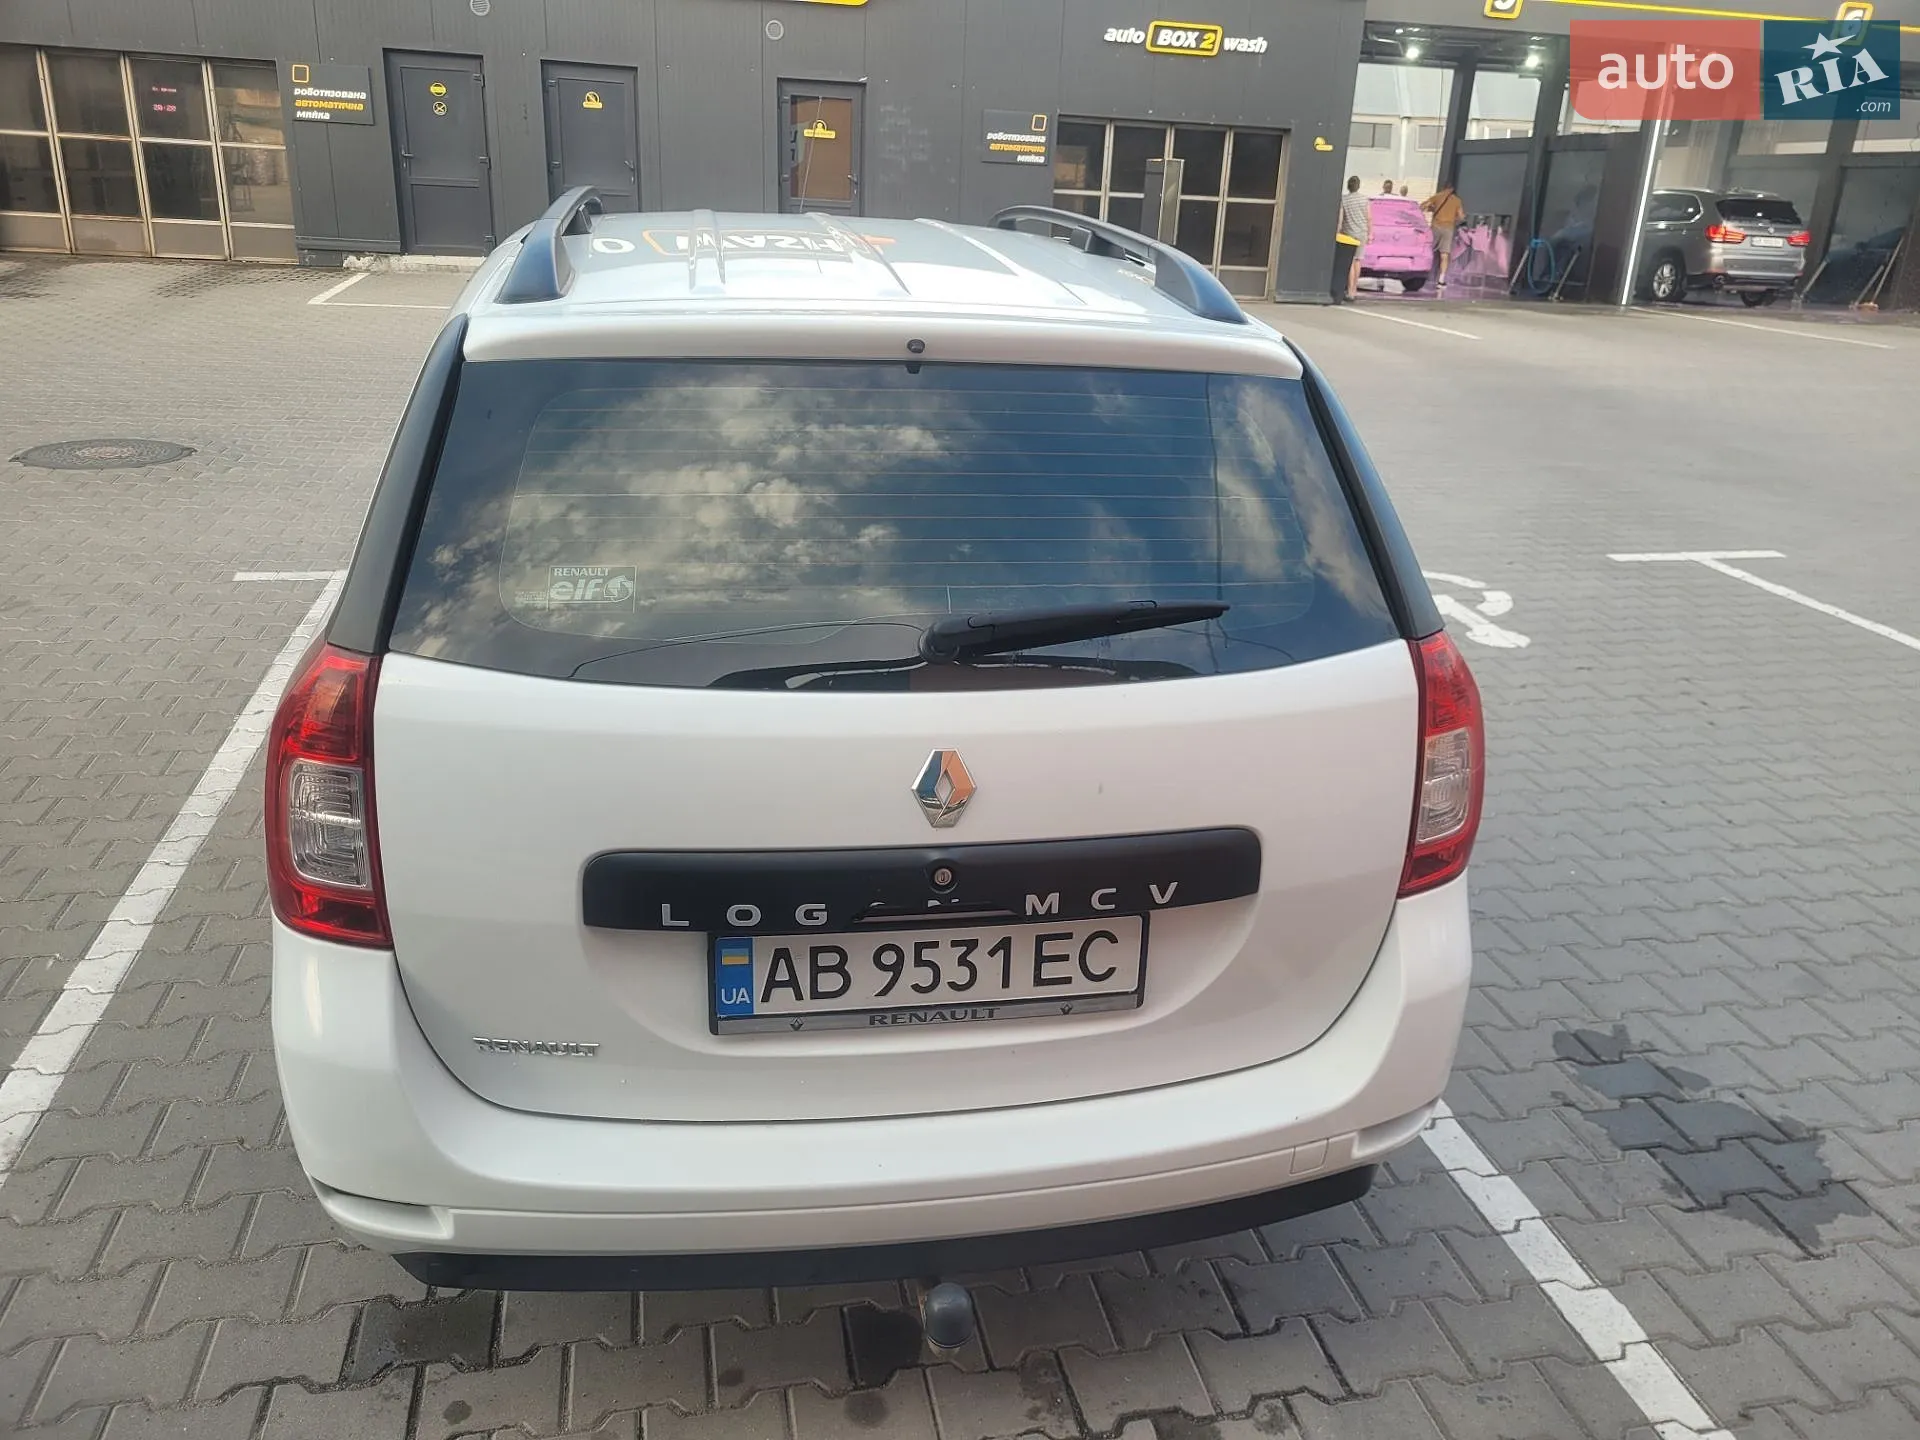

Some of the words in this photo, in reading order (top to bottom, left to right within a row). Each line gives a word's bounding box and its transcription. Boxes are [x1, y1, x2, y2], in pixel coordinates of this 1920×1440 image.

[1103, 27, 1146, 44] auto
[1156, 29, 1199, 48] BOX
[1200, 32, 1216, 49] 2
[1223, 37, 1268, 53] wash
[294, 87, 367, 100] роботизована
[295, 99, 364, 111] автоматична
[296, 110, 331, 120] мийка
[553, 567, 610, 577] RENAULT
[550, 578, 604, 601] elf
[660, 898, 961, 928] LOG
[1024, 881, 1179, 917] MCV
[760, 944, 852, 1003] AB
[872, 936, 1012, 997] 9531
[1032, 930, 1119, 988] EC
[720, 987, 750, 1005] UA
[868, 1007, 1000, 1026] RENAULT
[472, 1036, 600, 1057] RENAULT
